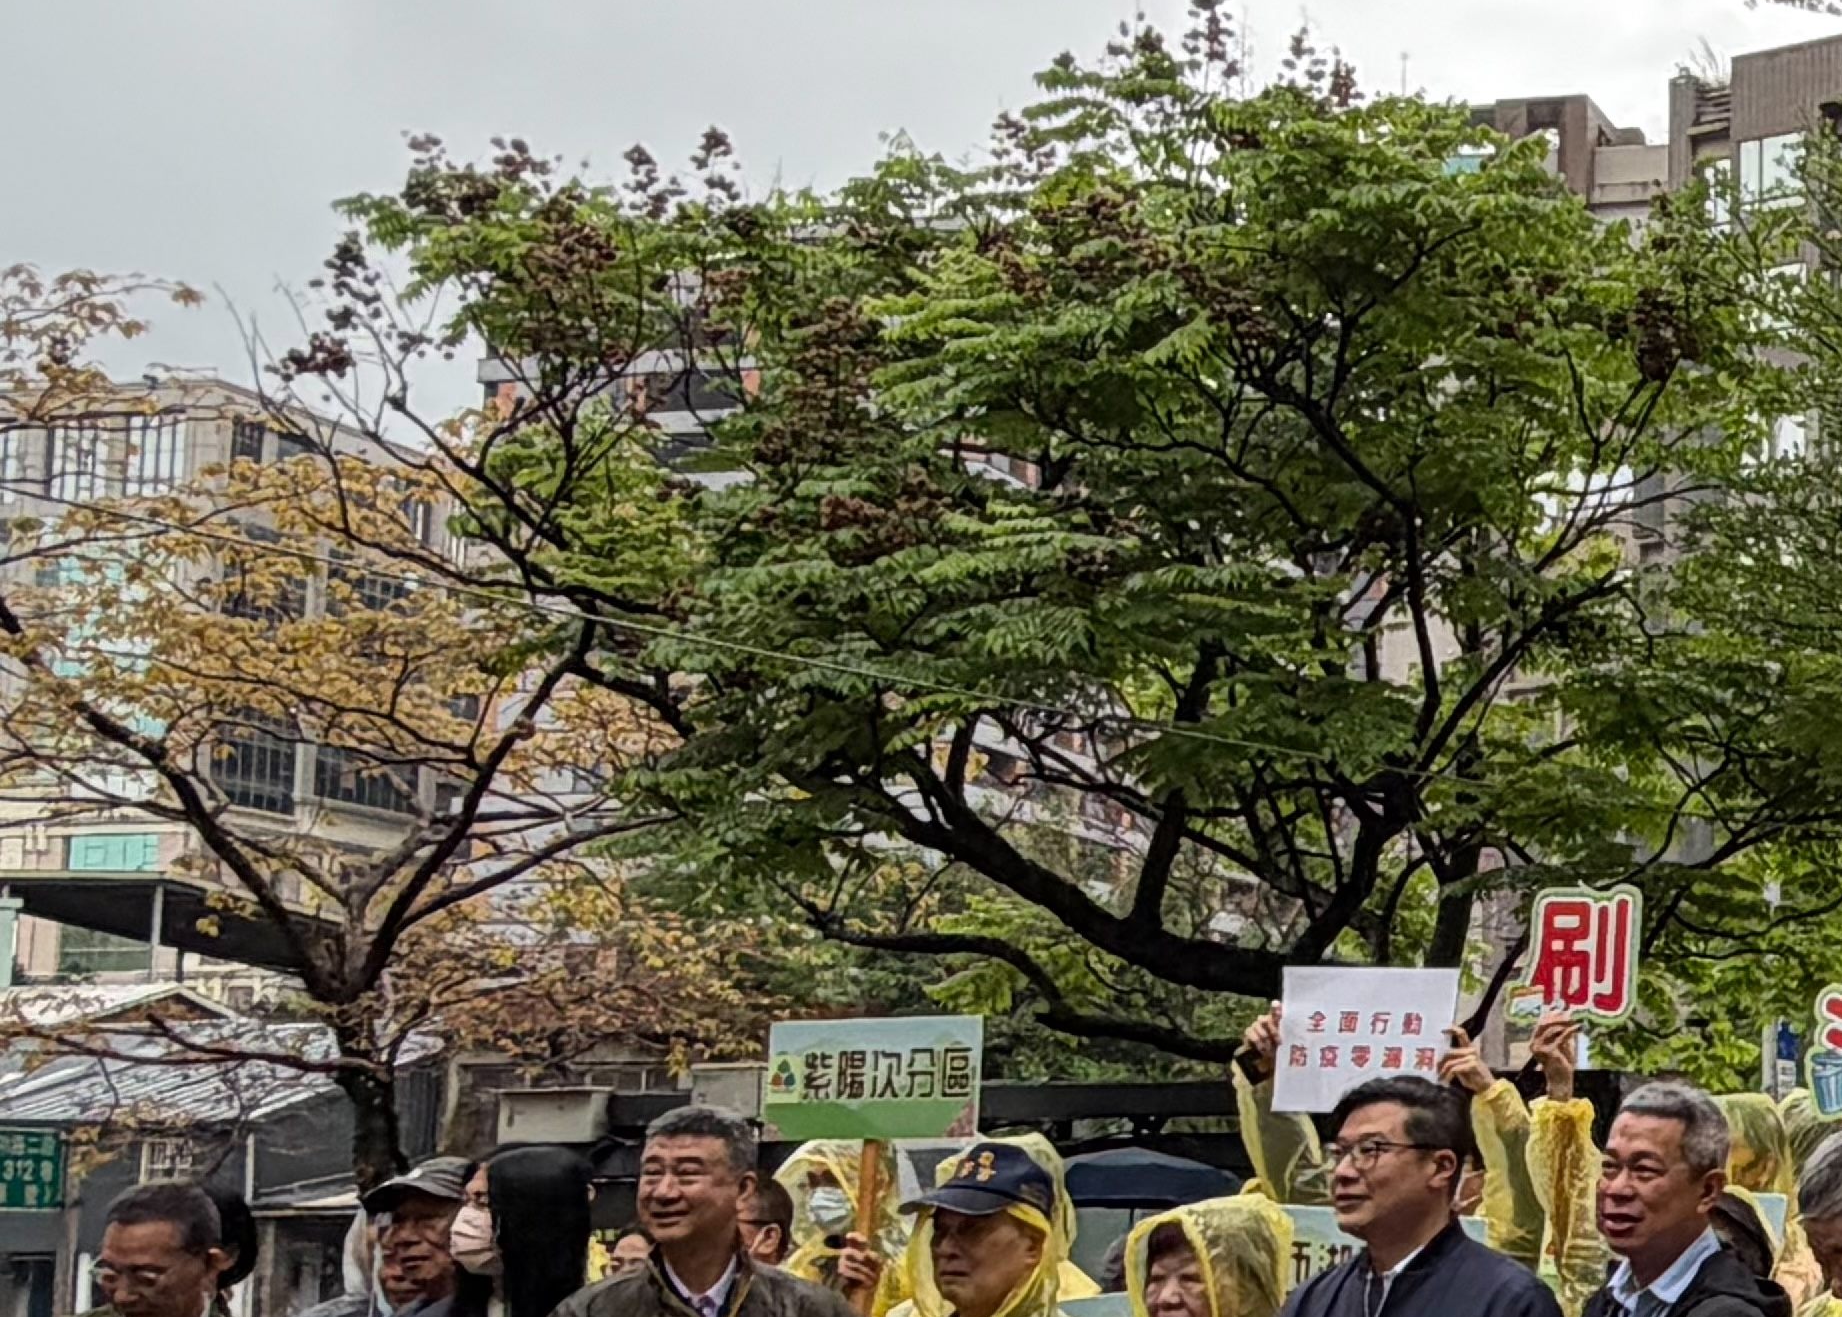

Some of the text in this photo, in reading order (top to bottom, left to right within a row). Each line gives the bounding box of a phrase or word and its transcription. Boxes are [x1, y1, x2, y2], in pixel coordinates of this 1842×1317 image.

[1532, 898, 1629, 1012] 刷
[803, 1046, 973, 1100] 紫陽次分區
